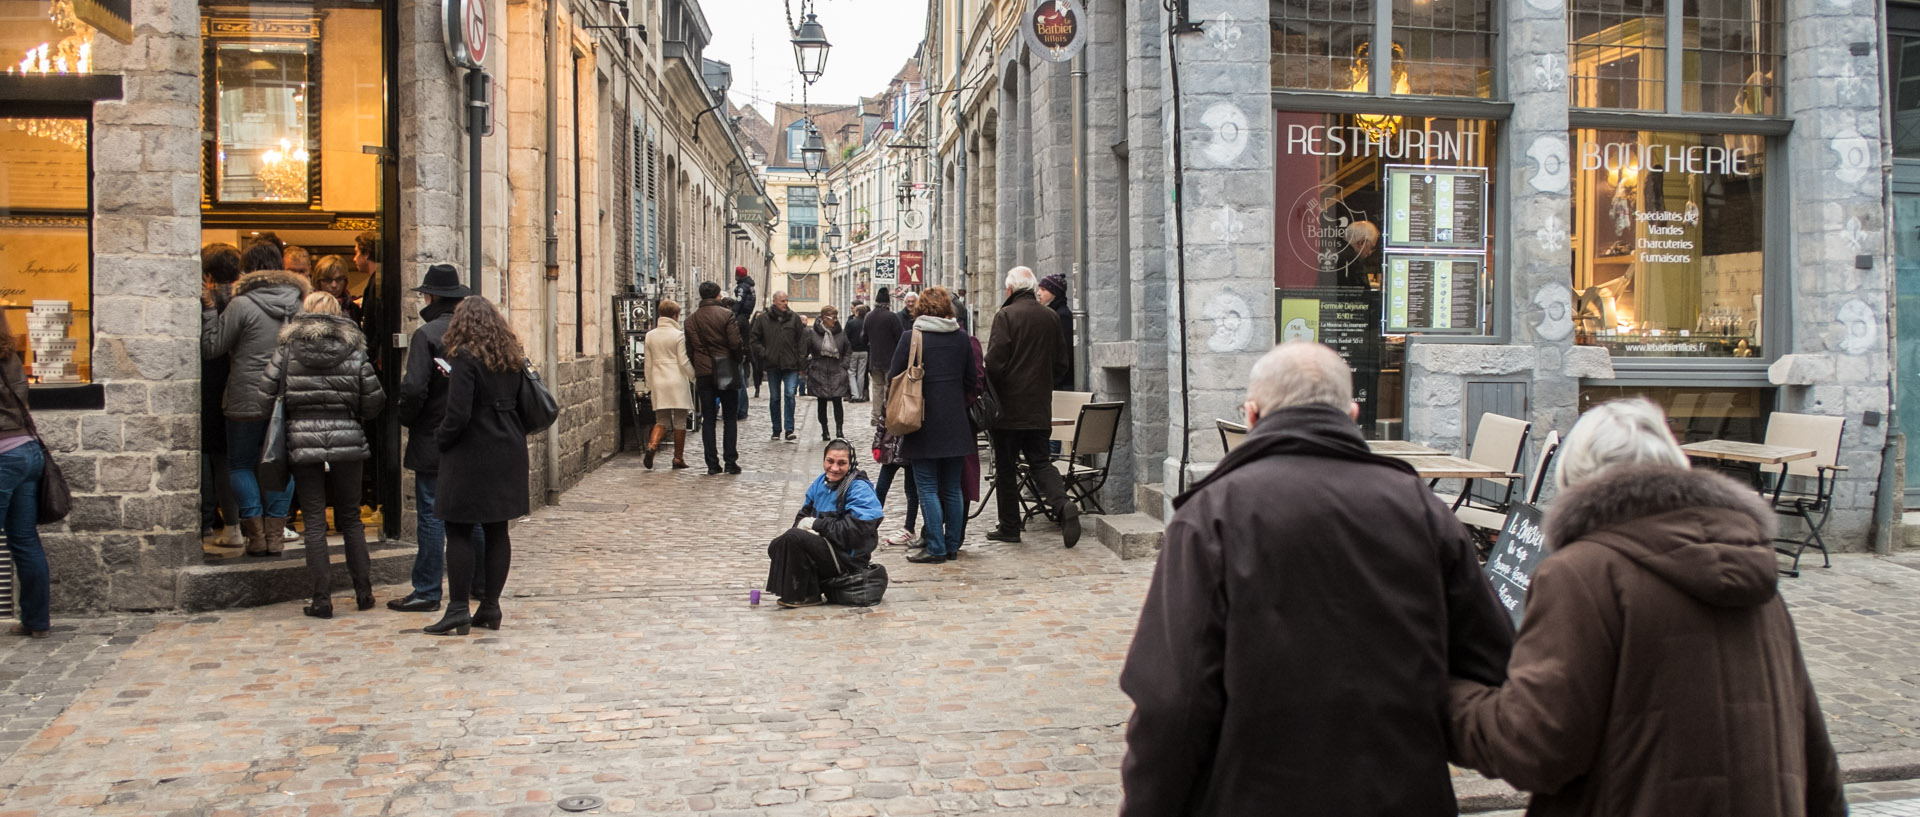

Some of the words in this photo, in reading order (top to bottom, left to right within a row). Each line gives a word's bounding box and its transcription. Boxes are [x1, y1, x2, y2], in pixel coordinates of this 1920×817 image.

[1037, 24, 1072, 34] Barbier
[1287, 124, 1478, 161] RESTAURANT
[1581, 142, 1750, 176] BOUCHERIE
[1635, 210, 1682, 223] Spécialités
[1307, 224, 1348, 238] Barbier
[1648, 225, 1684, 235] Viandes
[1315, 239, 1342, 247] lillois
[1638, 238, 1694, 249] Charcuteries
[1640, 251, 1691, 262] Fumaisons
[0, 286, 26, 298] ique
[1320, 302, 1343, 310] Formule
[1344, 302, 1369, 311] Déjeuner
[1625, 343, 1708, 352] www.lebarbierlillois.fr
